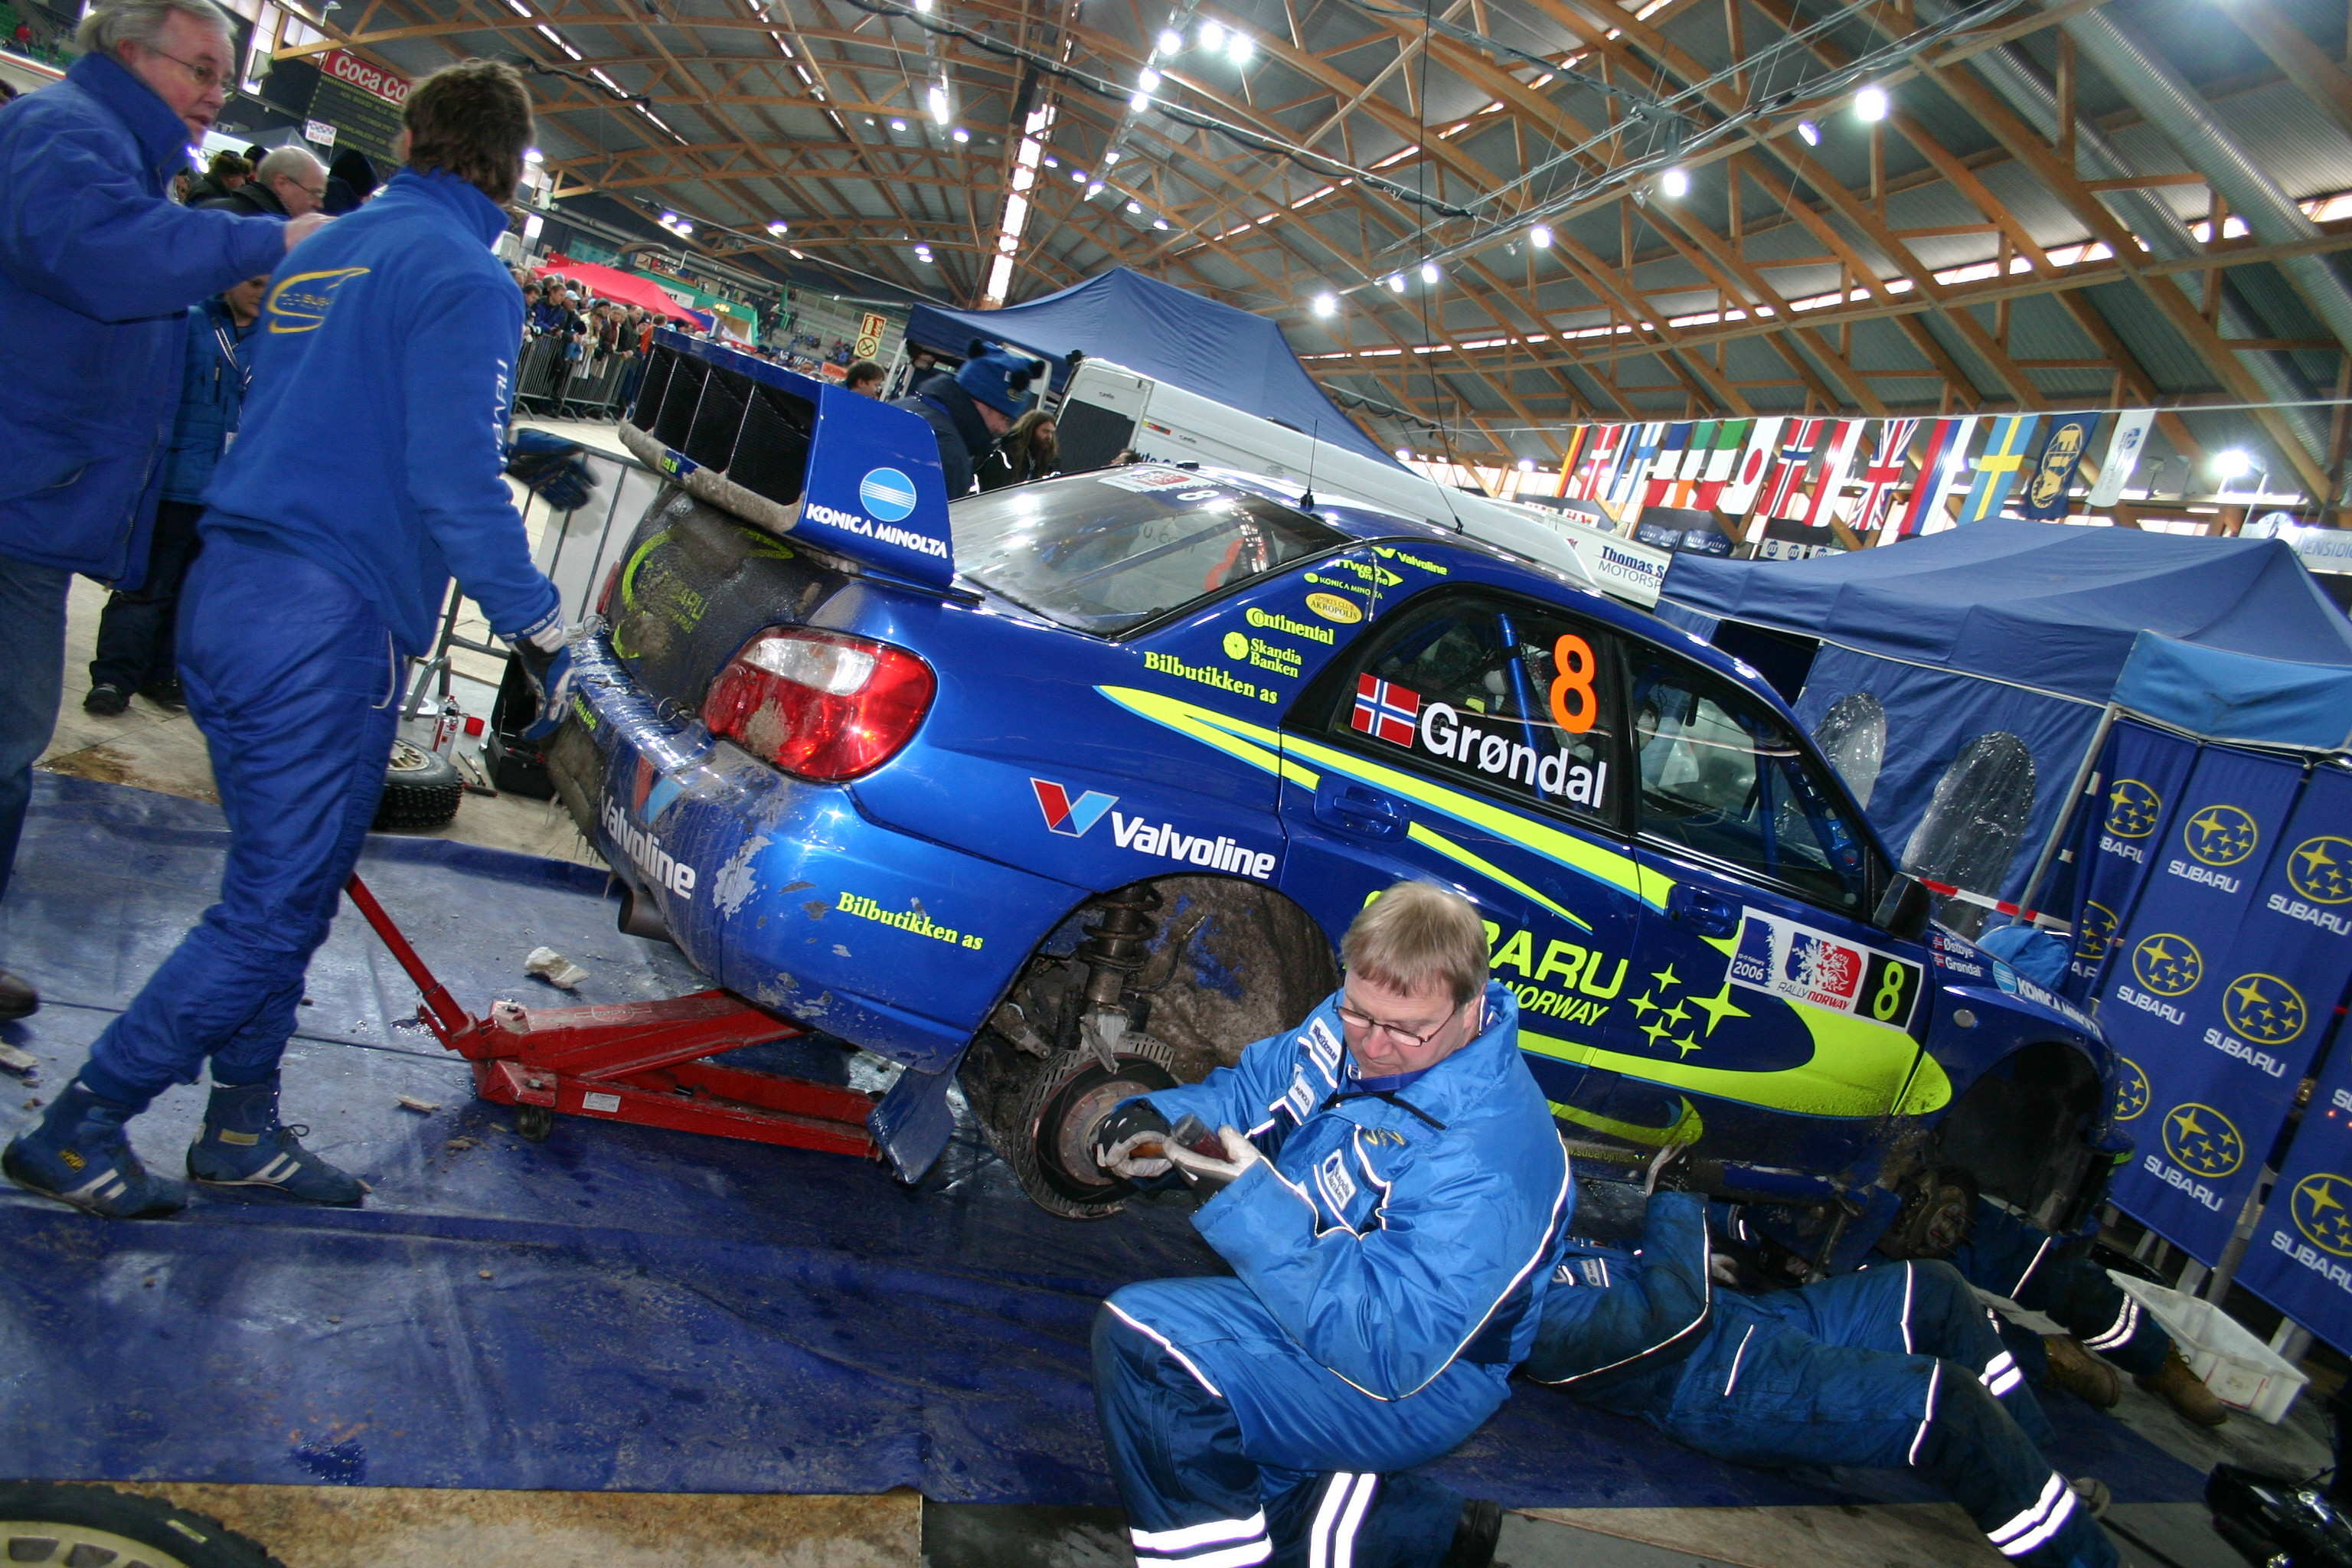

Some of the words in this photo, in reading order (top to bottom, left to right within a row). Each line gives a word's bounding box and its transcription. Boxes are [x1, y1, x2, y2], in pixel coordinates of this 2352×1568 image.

[335, 55, 381, 91] Coca
[384, 77, 410, 101] Co
[806, 502, 873, 537] KONICA
[874, 523, 948, 559] MINOLTA
[1396, 551, 1449, 575] Valvoline
[1597, 559, 1662, 590] MOTORSP
[1600, 544, 1654, 577] Thomas
[1319, 577, 1350, 591] KONICA
[1351, 584, 1383, 600] MINOTA
[1246, 606, 1334, 645] Continental
[1310, 599, 1358, 621] AKROPOLIS
[1250, 638, 1302, 666] Skandia
[1250, 652, 1299, 678] Banken
[1143, 651, 1256, 698] Bilbutikken
[1259, 688, 1278, 704] as
[1550, 633, 1597, 734] 8
[1420, 701, 1607, 808] Grøndal
[600, 786, 697, 900] Valvoline
[1112, 811, 1276, 880] Valvoline
[2167, 859, 2240, 893] SUBARU
[835, 891, 958, 944] Bilbutikken
[962, 933, 984, 950] as
[2266, 893, 2352, 936] SUBARU
[1733, 961, 1765, 981] 2006
[1945, 956, 1982, 978] Grøndal
[1776, 982, 1808, 999] RALLY
[1807, 991, 1851, 1011] NORWAY
[1873, 961, 1906, 1022] 8
[2016, 977, 2062, 1012] KONICA
[2116, 985, 2186, 1026] SUBARU
[2203, 1027, 2287, 1079] SUBARU
[2143, 1155, 2224, 1213] SUBARU
